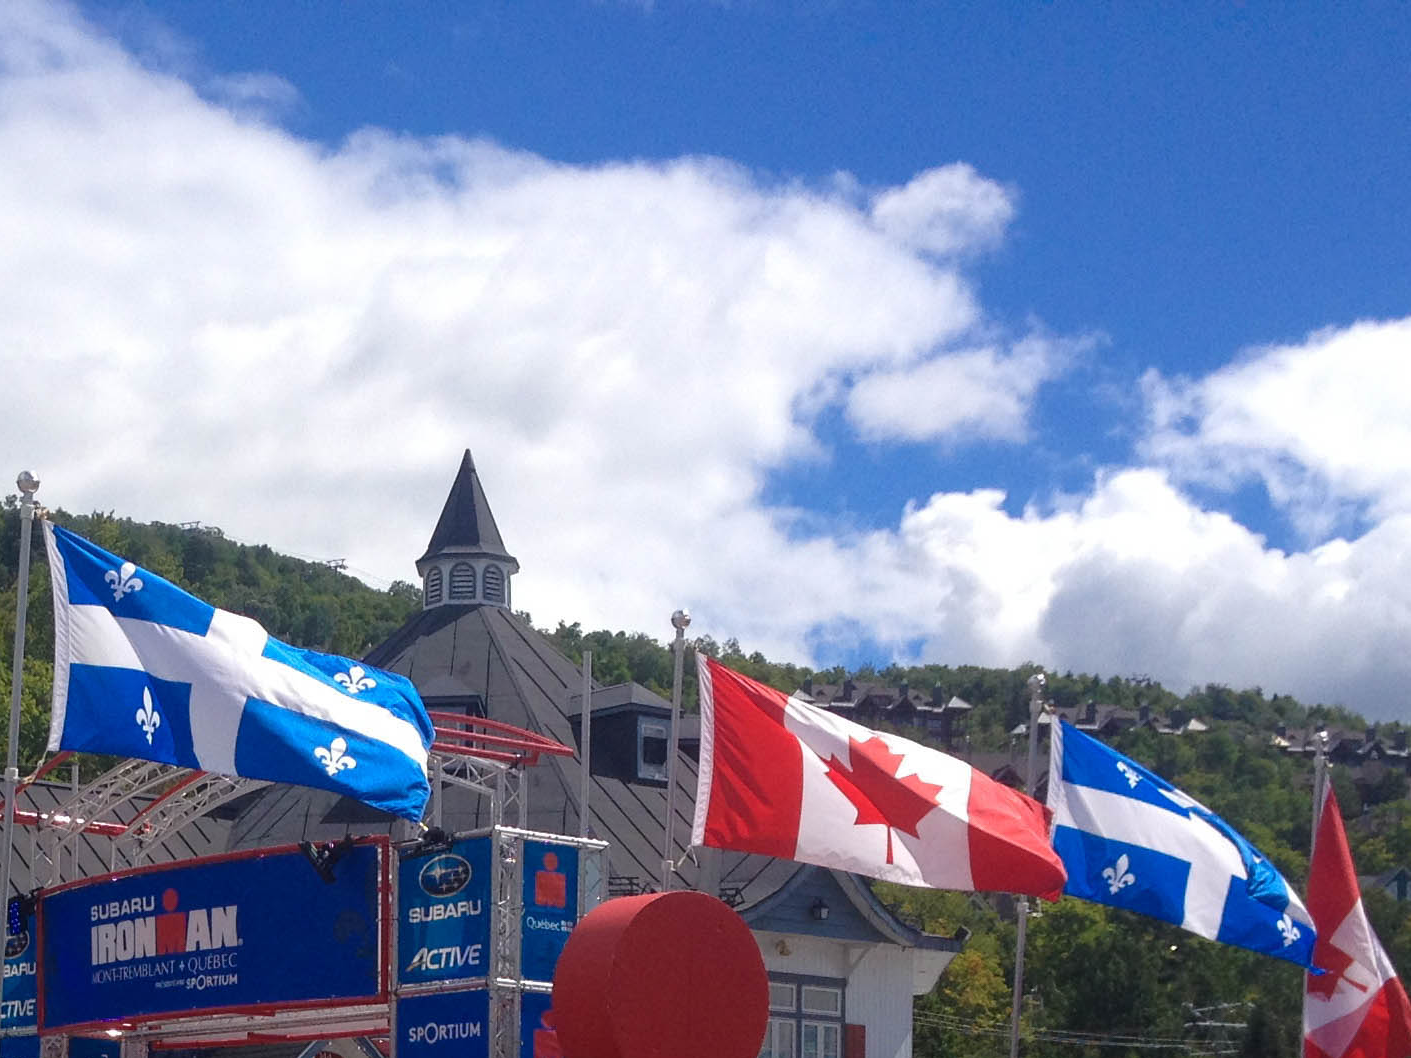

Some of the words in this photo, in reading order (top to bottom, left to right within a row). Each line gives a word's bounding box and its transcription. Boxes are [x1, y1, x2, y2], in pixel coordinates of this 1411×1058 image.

[91, 895, 155, 922] SUBARU
[408, 900, 482, 923] SUBARU
[91, 888, 239, 966] IRONMAN
[526, 916, 561, 932] Québec
[188, 952, 238, 975] QUÉBEC
[405, 944, 482, 972] ACTIVE
[186, 973, 238, 990] SPORTIUM
[408, 1022, 481, 1044] SPORTIUM
